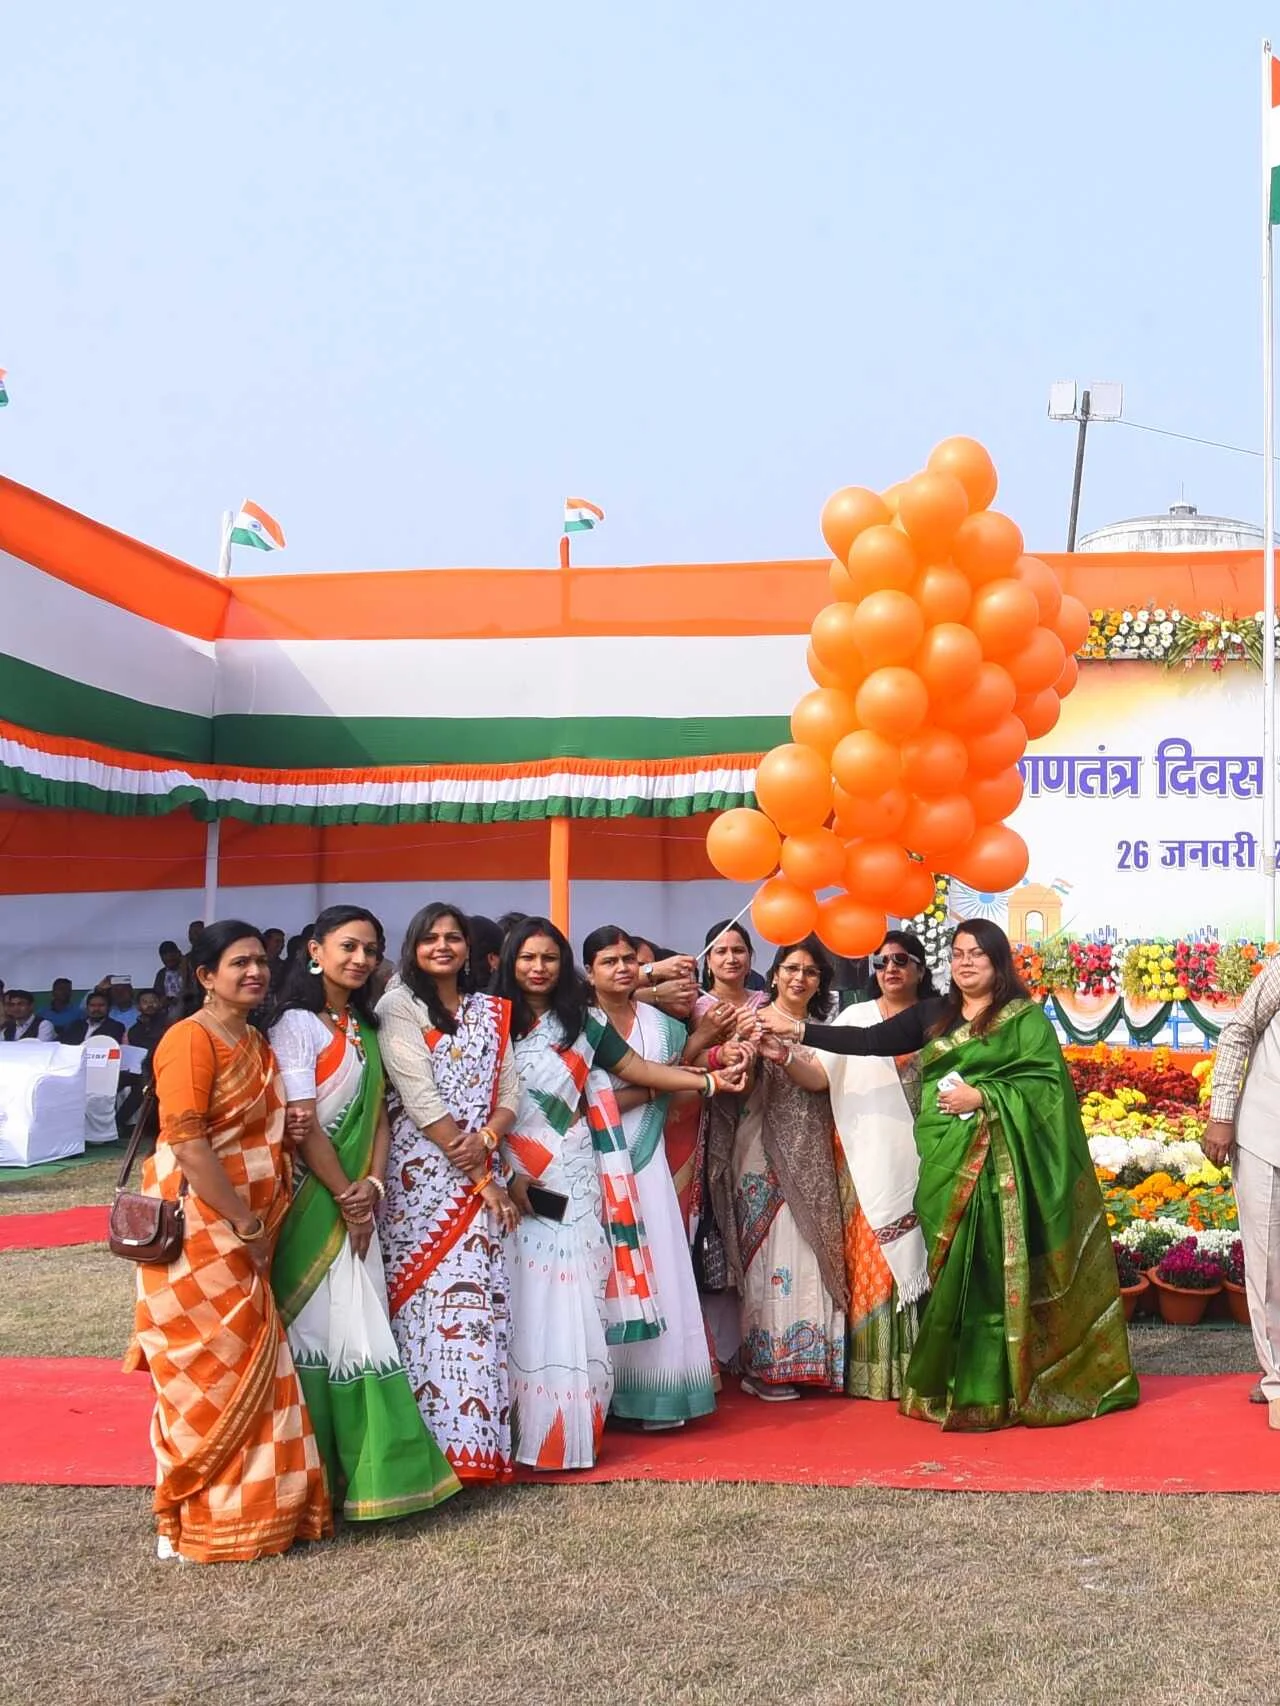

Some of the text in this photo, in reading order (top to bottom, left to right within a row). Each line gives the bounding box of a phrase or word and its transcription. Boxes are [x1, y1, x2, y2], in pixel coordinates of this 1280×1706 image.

[1018, 744, 1143, 798] गणतंत्र
[1154, 737, 1264, 797] दिवस
[1116, 839, 1150, 869] 26
[1158, 831, 1259, 869] जनवरी
